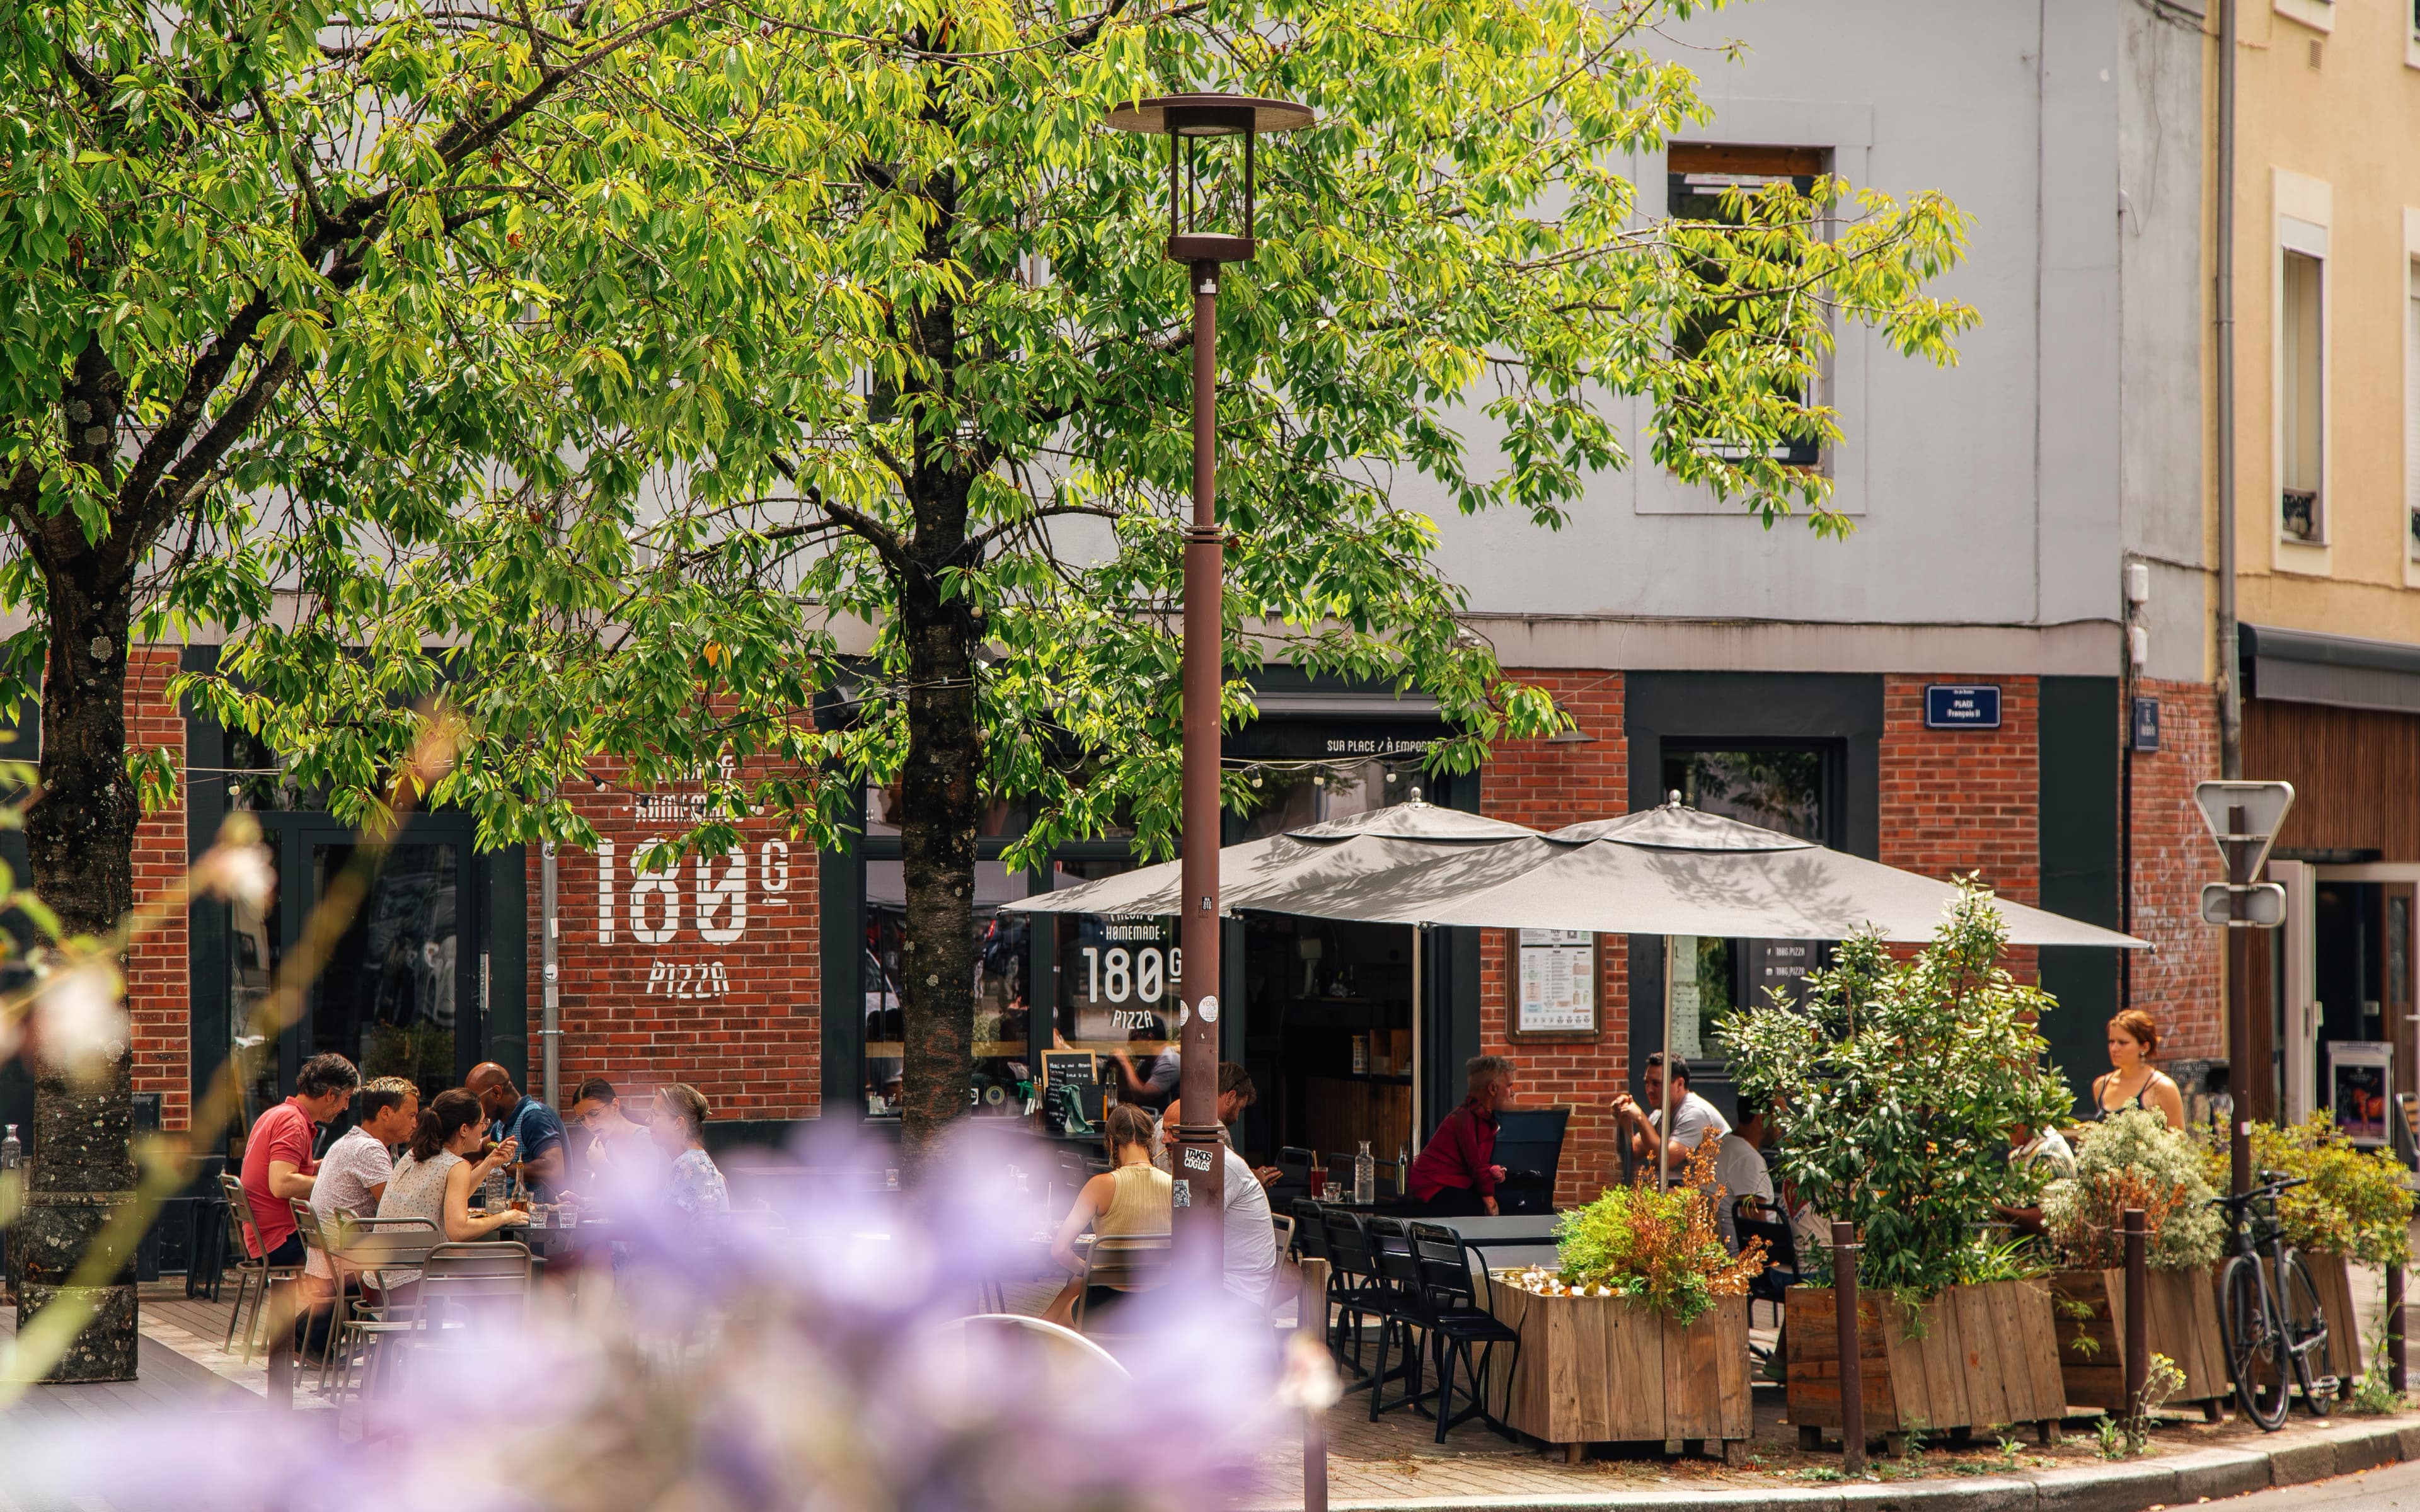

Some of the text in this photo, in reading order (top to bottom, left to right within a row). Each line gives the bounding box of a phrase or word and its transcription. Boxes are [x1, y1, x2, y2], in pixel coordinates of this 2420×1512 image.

[1954, 700, 1974, 708] PLACE
[1947, 709, 1974, 718] François
[1327, 740, 1345, 752] SUR
[1348, 740, 1375, 752] PLACE
[1387, 736, 1393, 752] À
[646, 961, 730, 999] PIZZA
[1110, 1009, 1154, 1029] PIZZA
[1187, 1148, 1212, 1162] TAKOS
